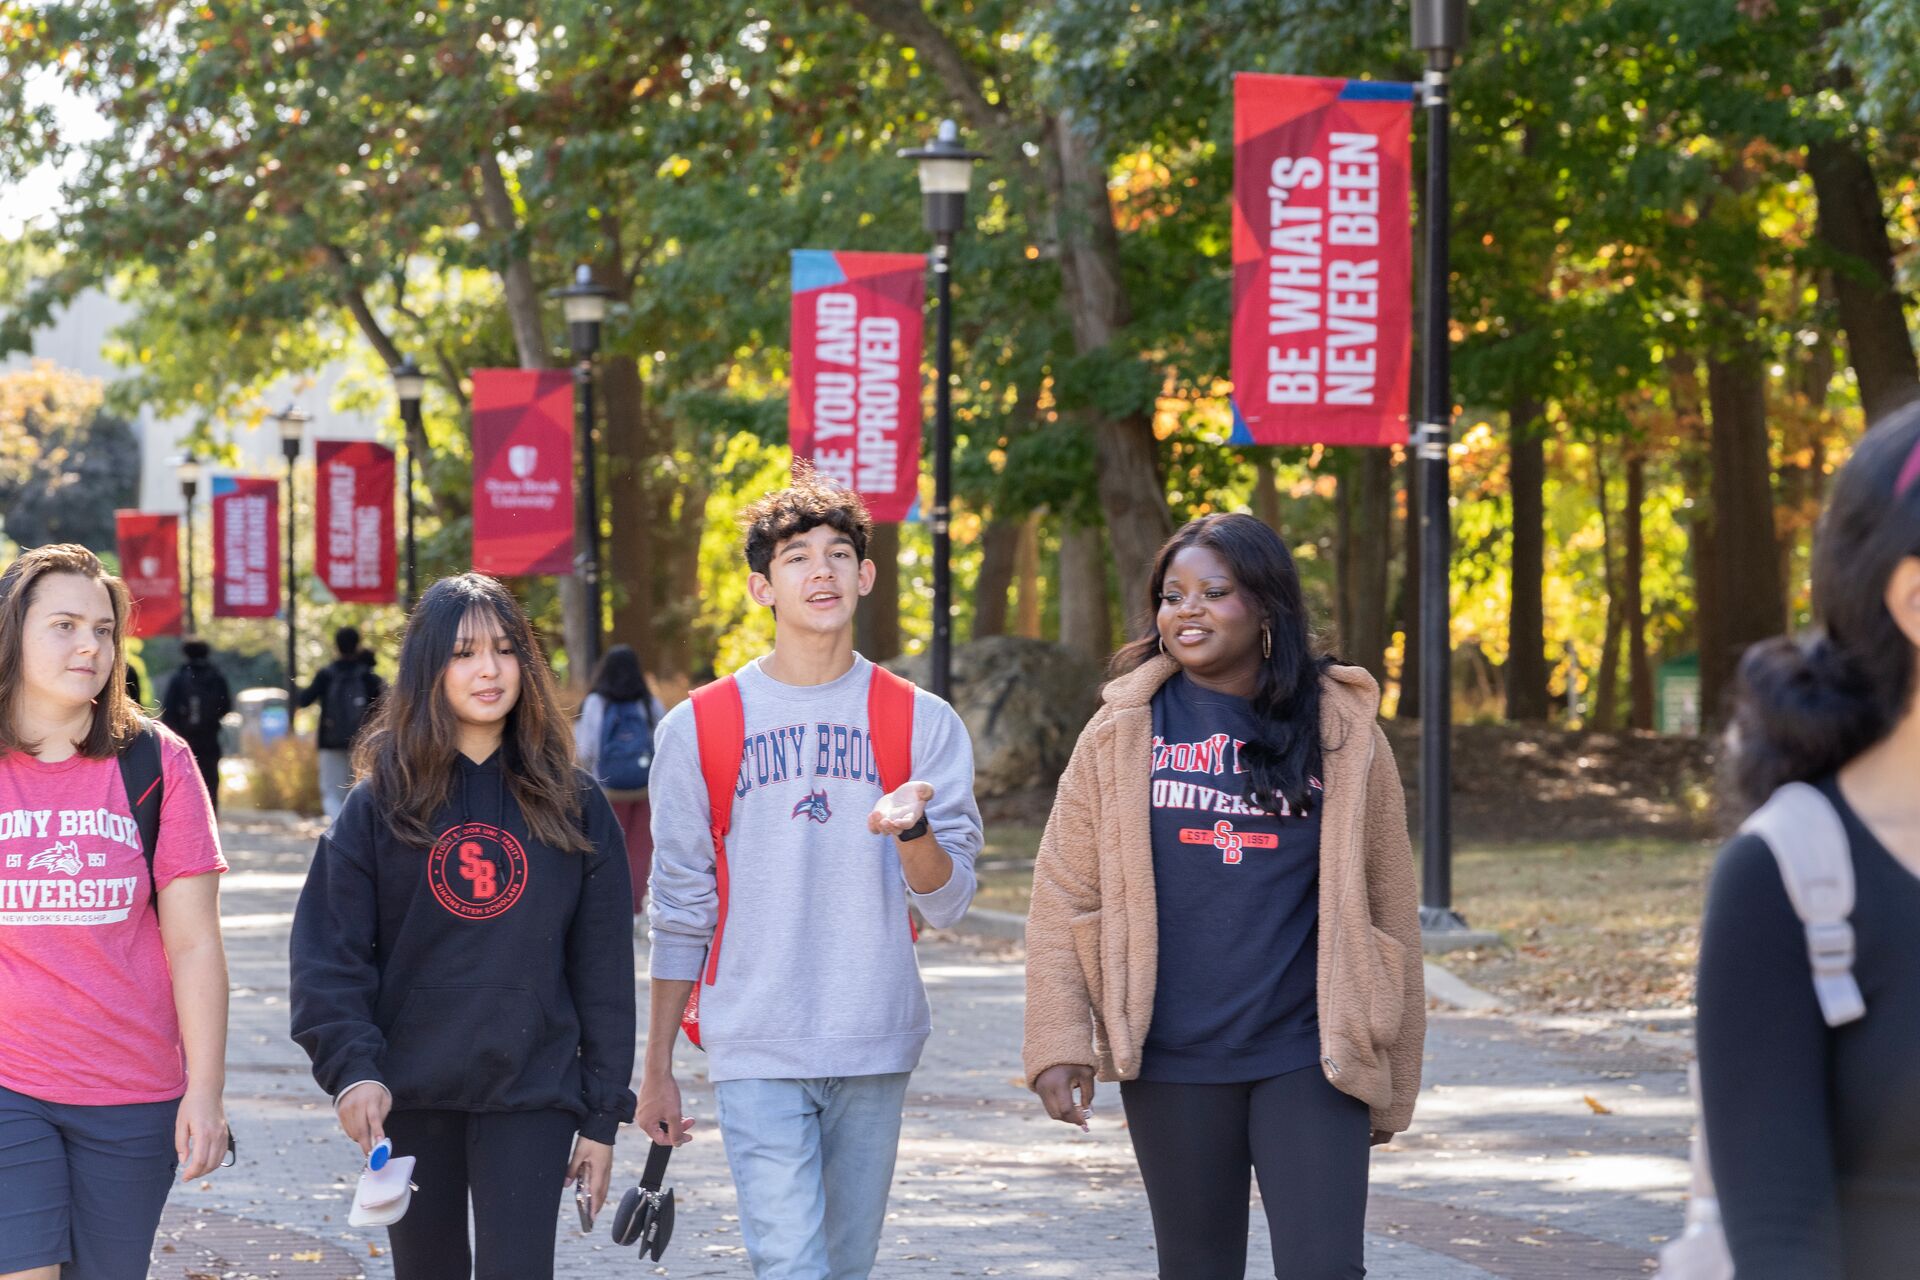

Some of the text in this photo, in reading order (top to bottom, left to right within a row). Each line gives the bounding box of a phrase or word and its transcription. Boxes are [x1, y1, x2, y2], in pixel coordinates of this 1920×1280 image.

[1267, 156, 1324, 405] BE WHAT'S
[1324, 132, 1380, 405] NEVER BEEN
[815, 293, 858, 366] AND
[814, 372, 856, 441] YOU
[857, 317, 900, 493] IMPROVED
[814, 722, 884, 793] BROO
[58, 807, 139, 850] BROOK
[452, 827, 481, 839] BOOK
[482, 828, 522, 860] UNIERSITY
[1213, 820, 1243, 865] SB
[458, 841, 498, 899] SB
